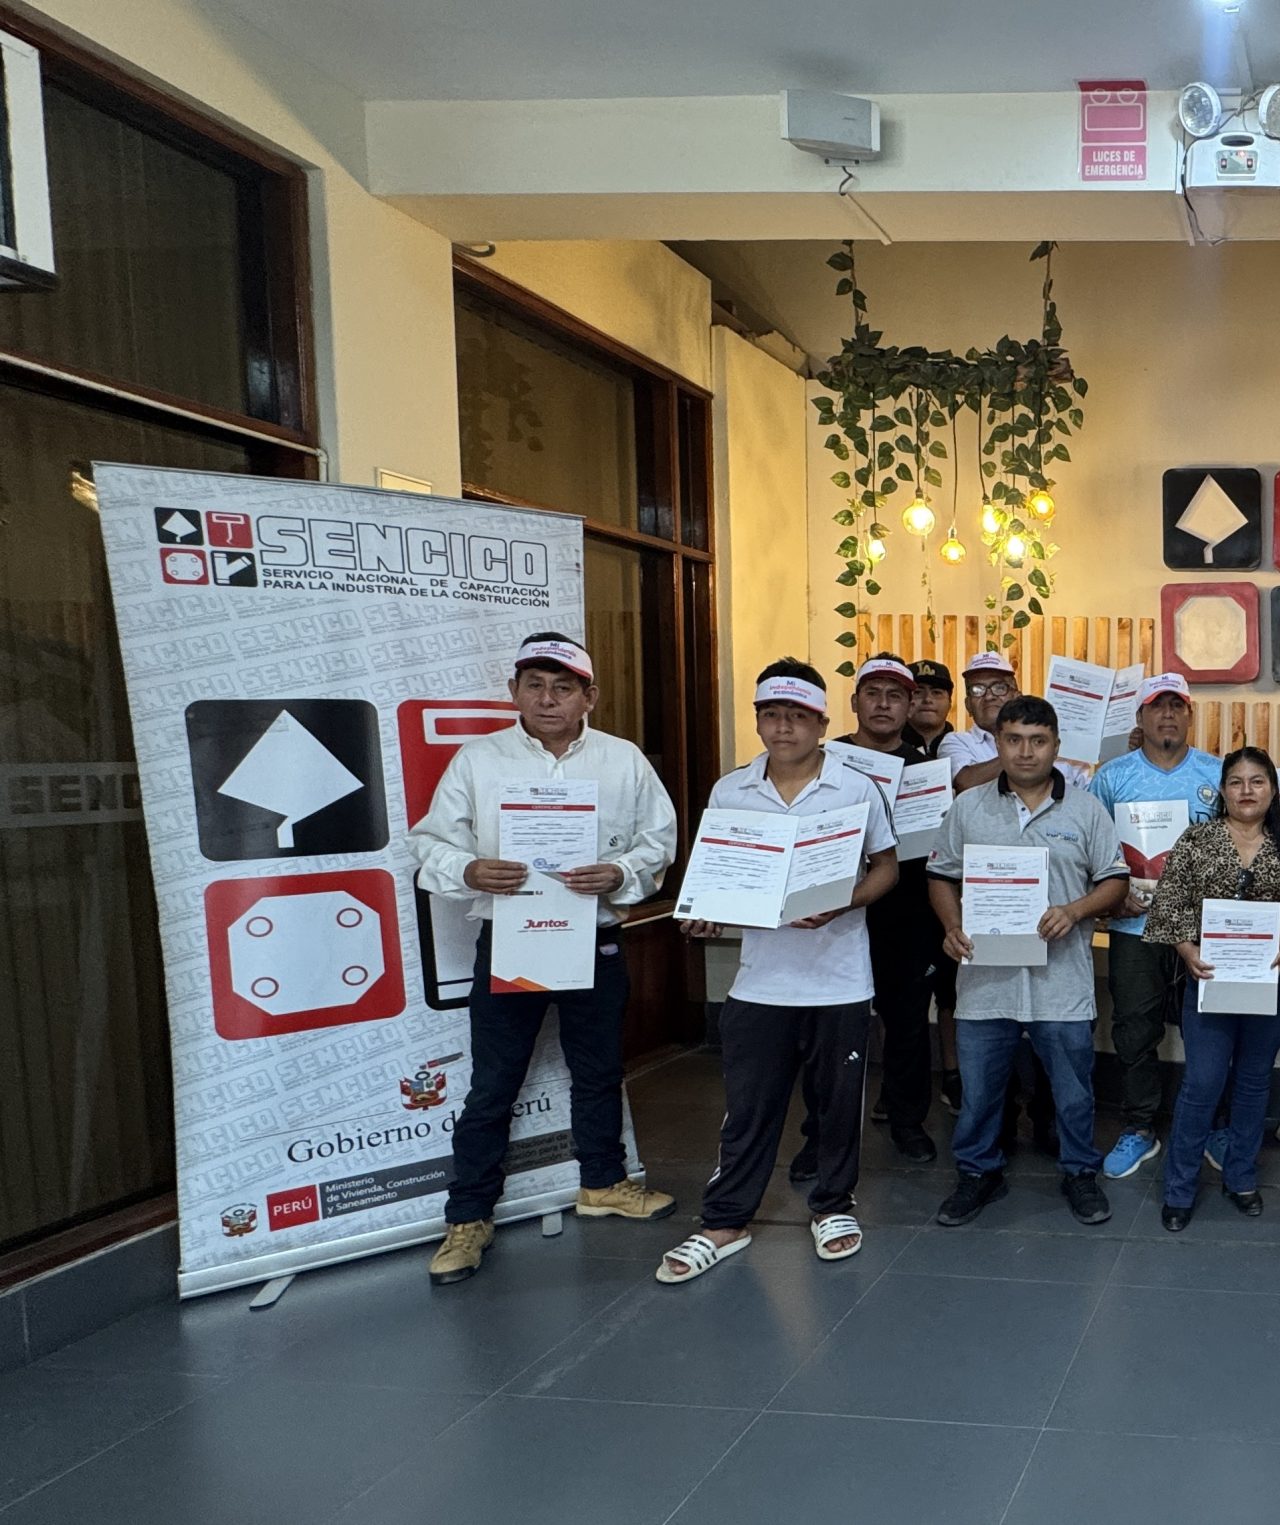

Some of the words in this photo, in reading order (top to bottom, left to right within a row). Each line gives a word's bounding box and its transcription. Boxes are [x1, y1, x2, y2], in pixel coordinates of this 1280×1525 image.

[1092, 150, 1121, 163] LUCES
[1123, 150, 1136, 162] DE
[1084, 164, 1144, 177] EMERGENCIA
[257, 515, 549, 588] SENCICO
[262, 568, 334, 580] SERVICIO
[346, 573, 419, 586] NACIONAL
[430, 578, 449, 588] DE
[459, 580, 550, 598] CAPACITACIÓN
[263, 579, 306, 590] PARA
[308, 581, 329, 591] LA
[331, 582, 407, 596] INDUSTRIA
[410, 587, 429, 597] DE
[431, 588, 450, 599] LA
[452, 590, 550, 608] CONSTRUCCIÓN
[523, 919, 569, 929] Juntos
[287, 1121, 431, 1163] Gobierno
[441, 1110, 456, 1133] d
[511, 1092, 552, 1118] erú
[325, 1177, 375, 1193] Ministerio
[326, 1194, 340, 1203] de
[386, 1170, 446, 1189] Construcción
[273, 1197, 313, 1217] PERÚ
[327, 1205, 334, 1215] y
[336, 1191, 398, 1211] Saneamiento
